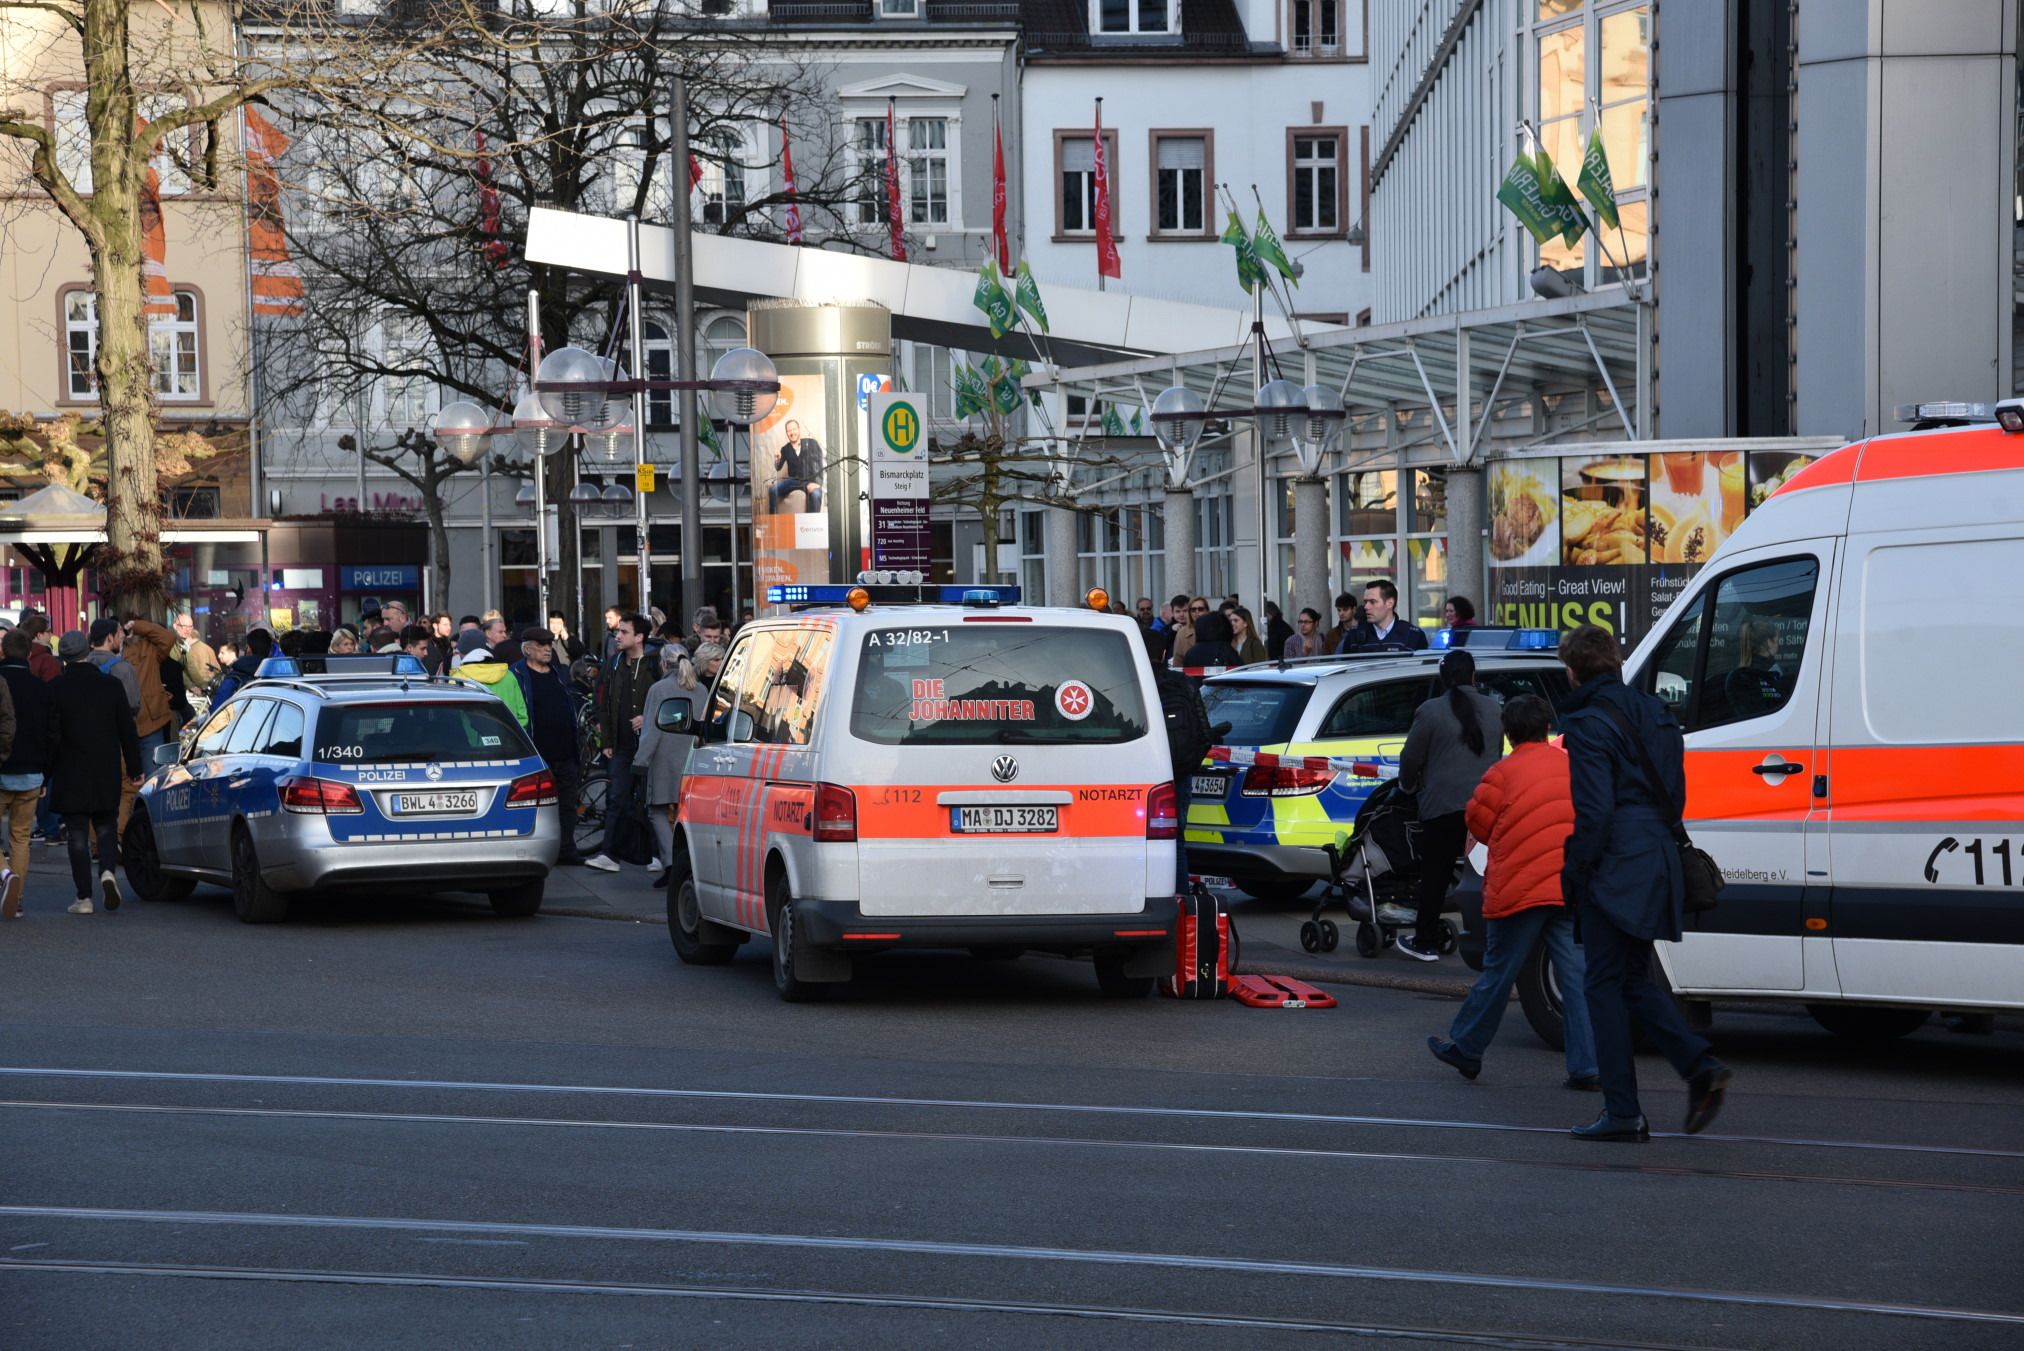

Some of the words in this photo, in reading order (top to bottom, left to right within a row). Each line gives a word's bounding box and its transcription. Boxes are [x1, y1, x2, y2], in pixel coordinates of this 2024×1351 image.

[893, 413, 909, 441] H
[880, 470, 924, 480] Bismarckplatz
[894, 483, 908, 491] Steig
[321, 492, 362, 513] Las
[878, 521, 886, 529] 31
[353, 571, 402, 585] POLIZEI
[1519, 579, 1546, 598] Eating
[1558, 578, 1589, 596] Great
[1591, 577, 1626, 595] View!
[869, 633, 881, 647] A
[885, 629, 950, 647] 32/82-1
[912, 679, 945, 699] DIE
[908, 700, 1036, 721] JOHANNITER
[317, 745, 363, 759] 1/340
[358, 771, 406, 782] POLIZEI
[166, 786, 191, 812] POLIZEI
[401, 795, 425, 810] BWL
[428, 795, 436, 810] 4
[445, 794, 476, 809] 3266
[893, 789, 921, 803] 112
[1079, 789, 1143, 802] NOTARZT
[773, 800, 805, 824] NOTARZT
[962, 809, 982, 826] MA
[994, 809, 1014, 826] DJ
[1017, 808, 1055, 826] 3282
[1964, 838, 2024, 886] 11
[1720, 867, 1768, 882] Heidelberg
[1770, 868, 1790, 880] e.V.
